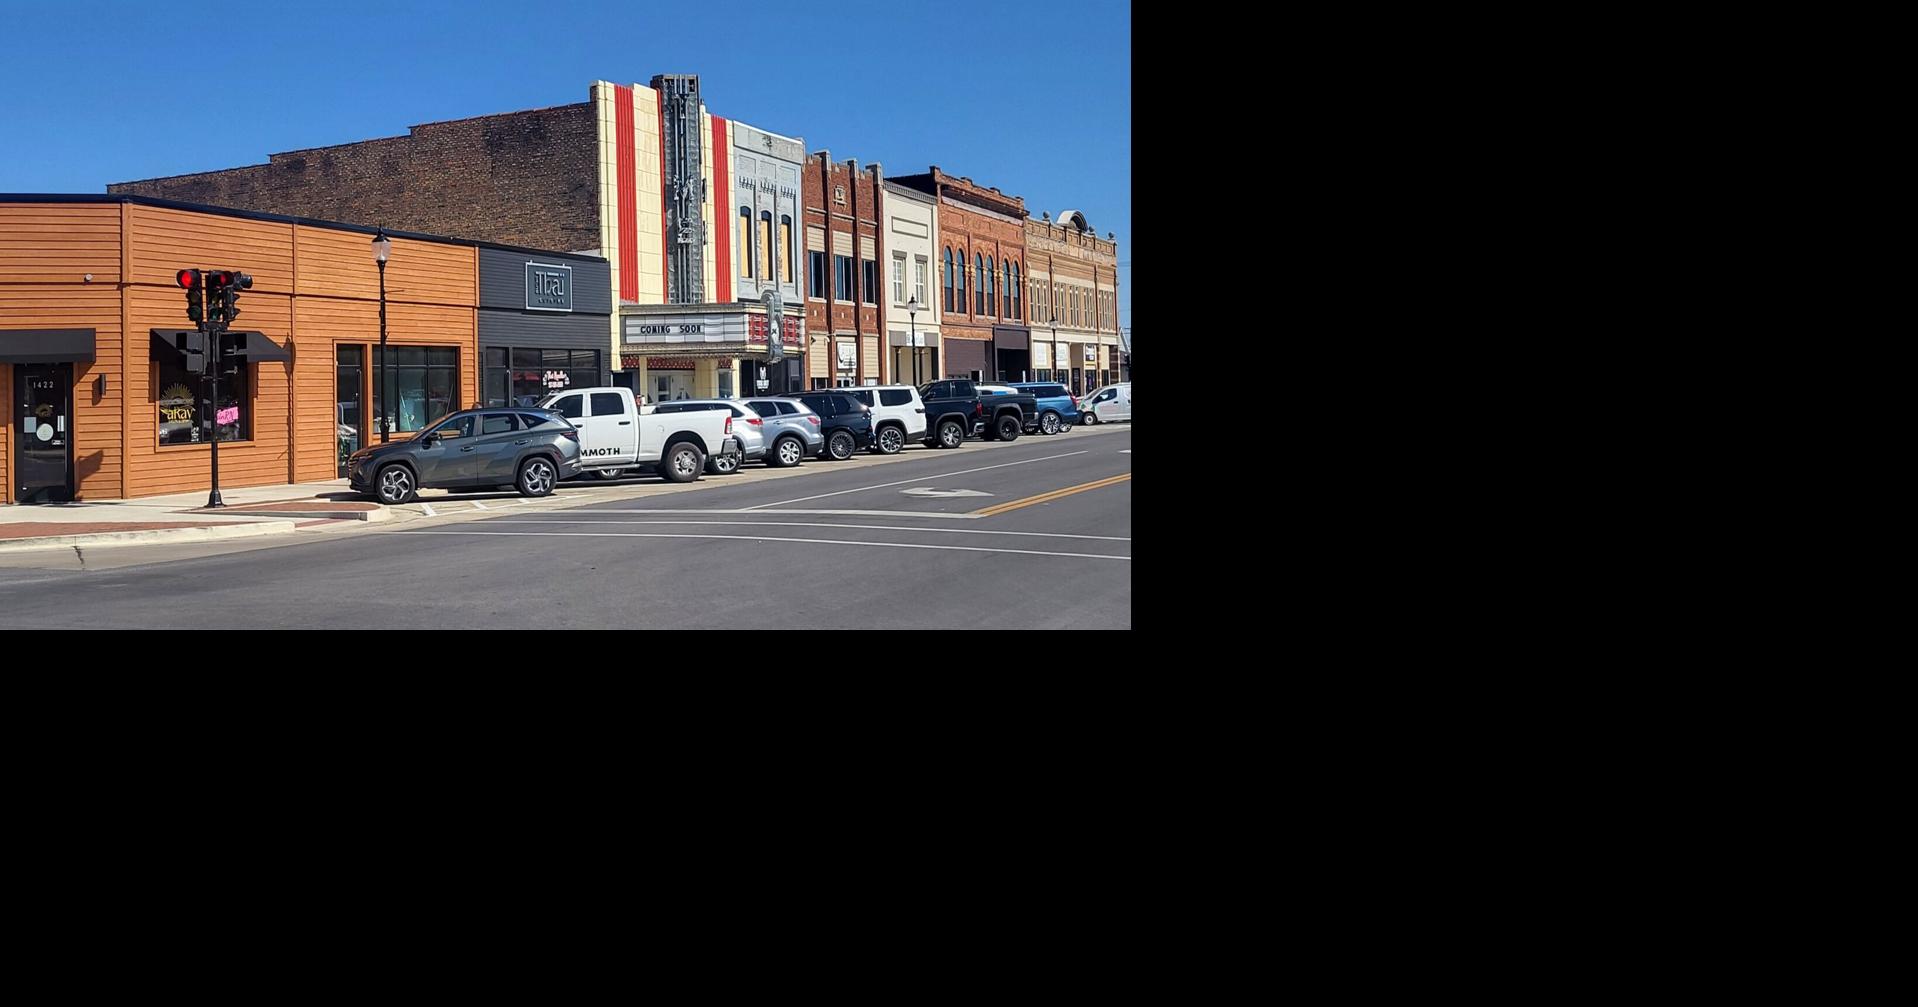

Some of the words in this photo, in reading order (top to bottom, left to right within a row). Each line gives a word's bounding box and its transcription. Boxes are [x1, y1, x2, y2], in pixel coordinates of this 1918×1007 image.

[640, 325, 671, 335] COMING
[680, 324, 701, 333] SOON
[33, 381, 54, 389] 1422
[580, 447, 620, 457] MMOTH
